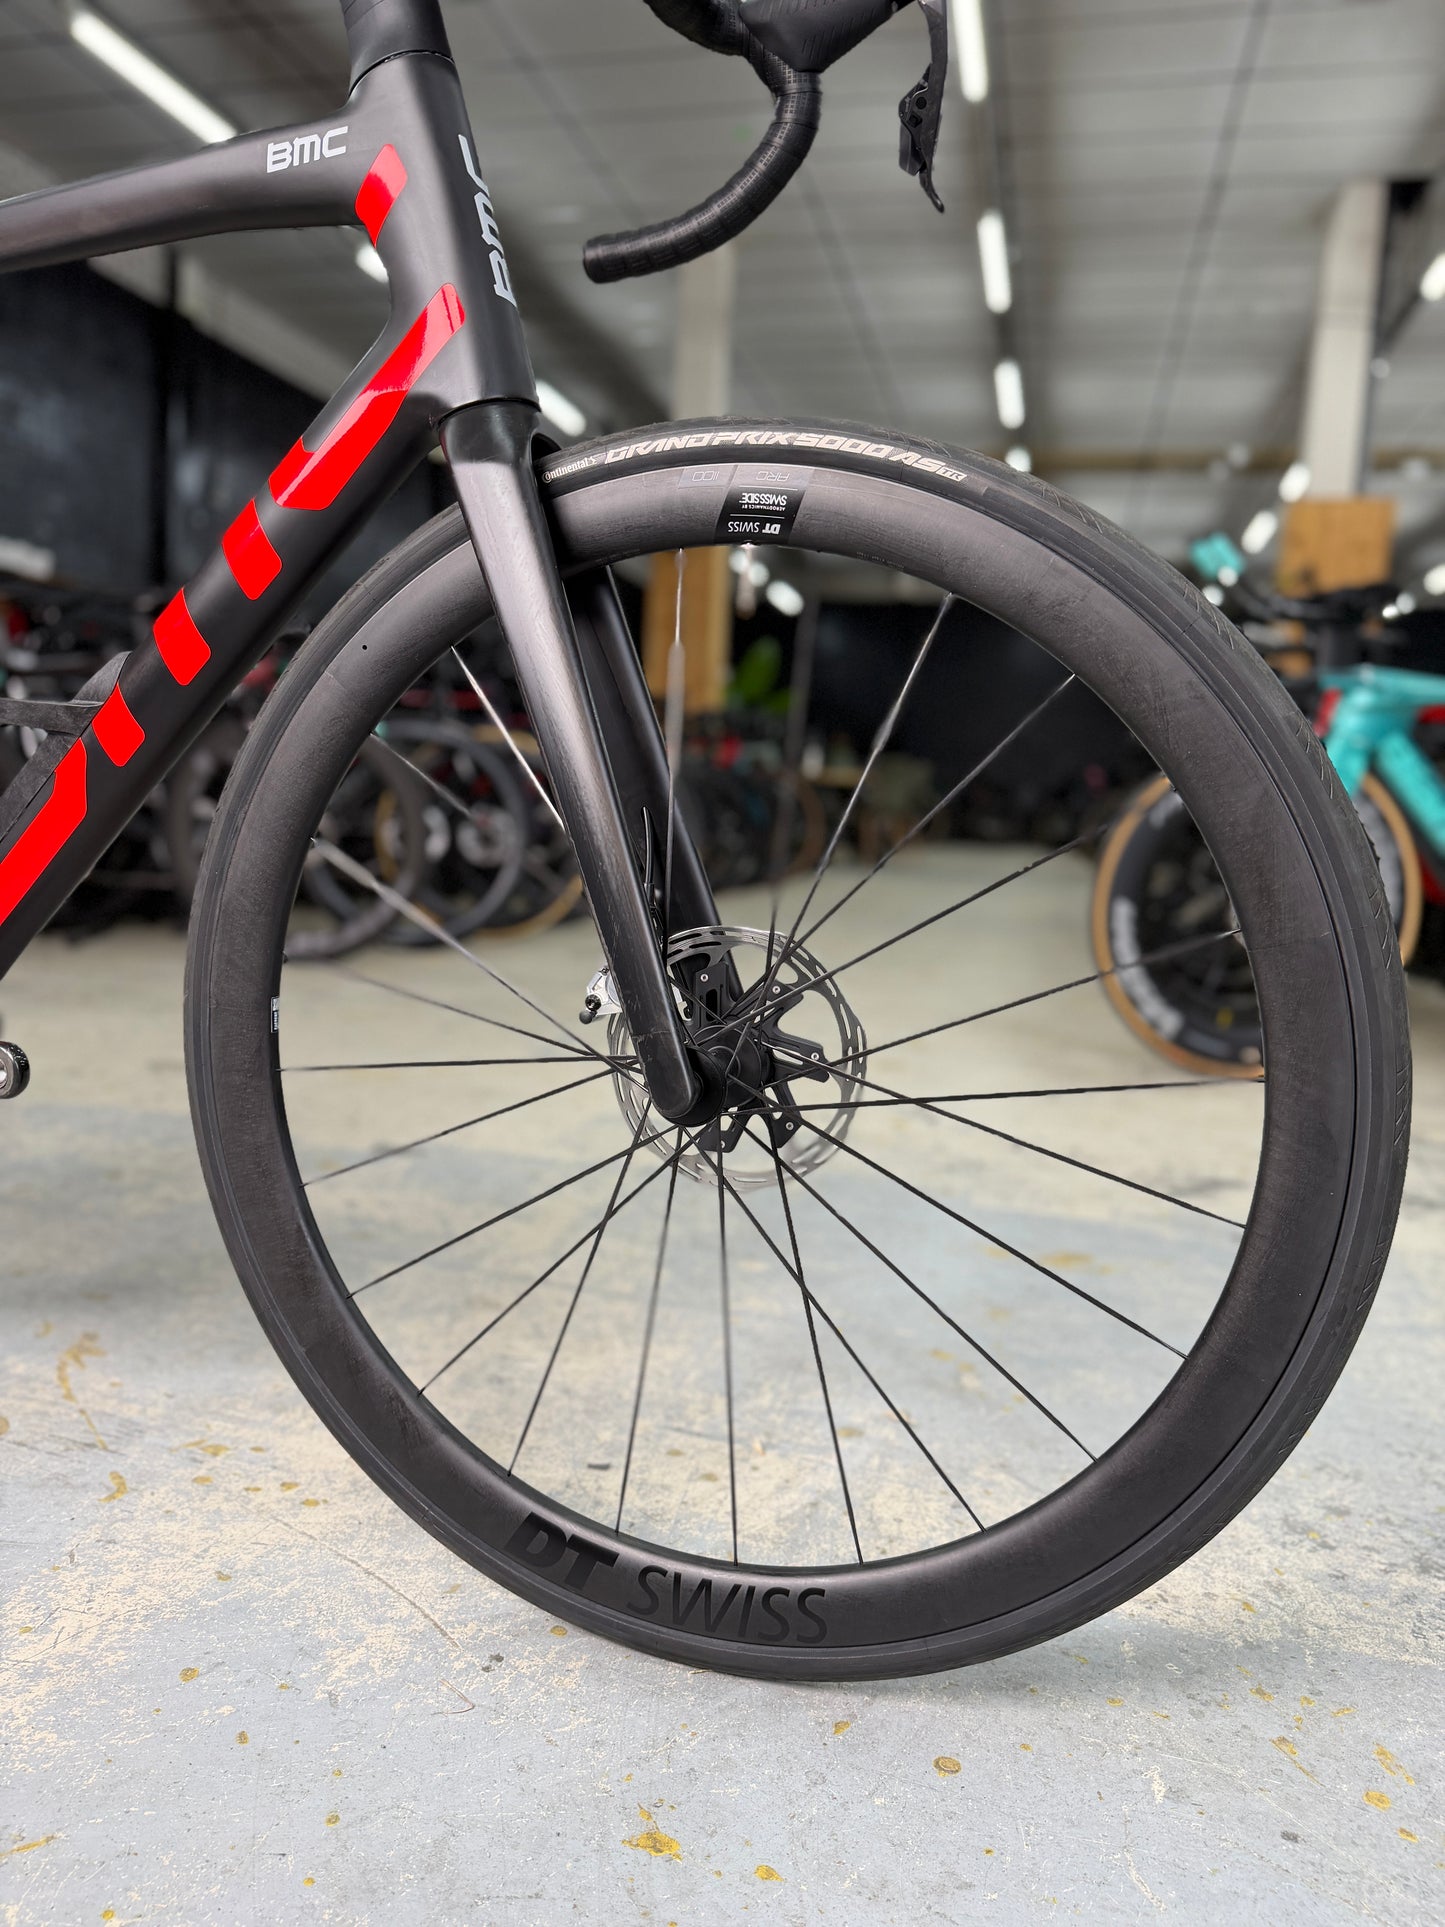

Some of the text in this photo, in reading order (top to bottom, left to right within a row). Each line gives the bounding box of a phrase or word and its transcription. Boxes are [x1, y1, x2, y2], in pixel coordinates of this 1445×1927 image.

[267, 126, 348, 173] BMC
[541, 457, 589, 484] Continental
[756, 471, 790, 481] ARC
[728, 521, 781, 535] DT SWISS
[504, 1511, 828, 1644] DT SWISS
